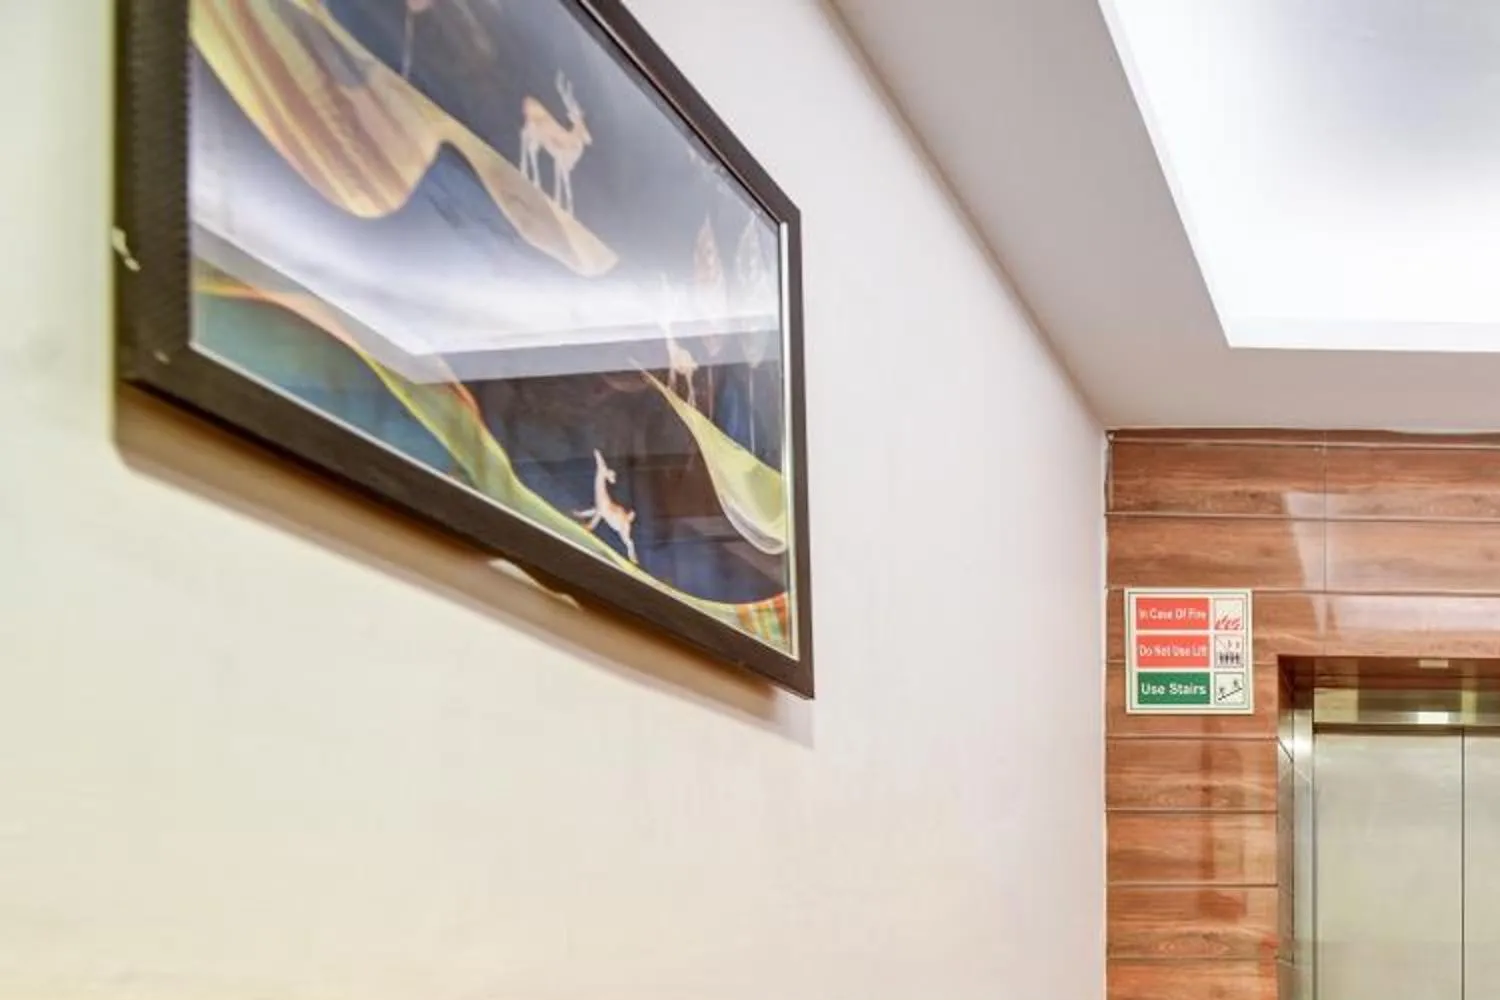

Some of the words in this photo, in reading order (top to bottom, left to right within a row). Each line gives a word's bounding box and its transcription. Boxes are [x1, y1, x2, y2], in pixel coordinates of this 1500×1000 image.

[1140, 644, 1153, 657] Do
[1154, 644, 1171, 657] Not
[1141, 681, 1165, 695] Use
[1169, 681, 1207, 695] Stairs
